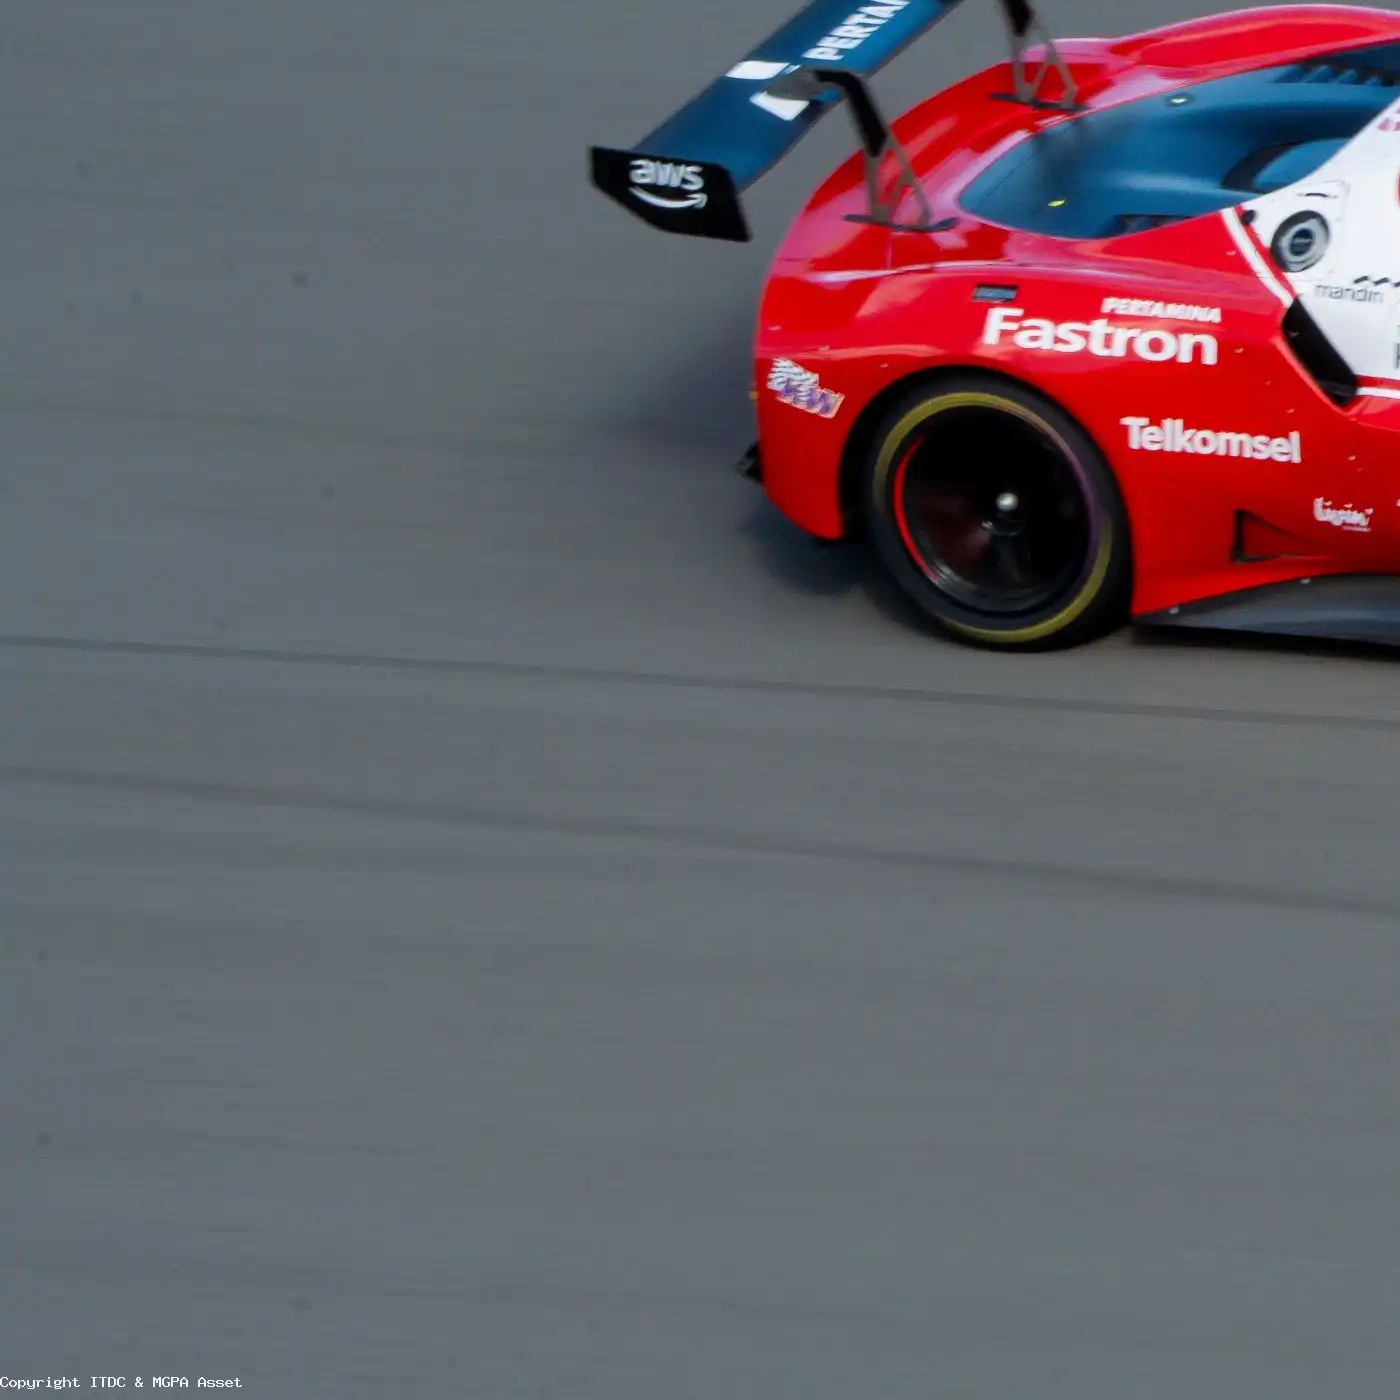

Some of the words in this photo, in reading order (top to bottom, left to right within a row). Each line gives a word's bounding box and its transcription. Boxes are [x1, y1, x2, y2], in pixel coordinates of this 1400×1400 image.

[629, 159, 705, 190] aws
[1102, 297, 1222, 324] PERTAMINA
[983, 306, 1218, 366] Fastron
[1120, 416, 1301, 464] Telkomsel
